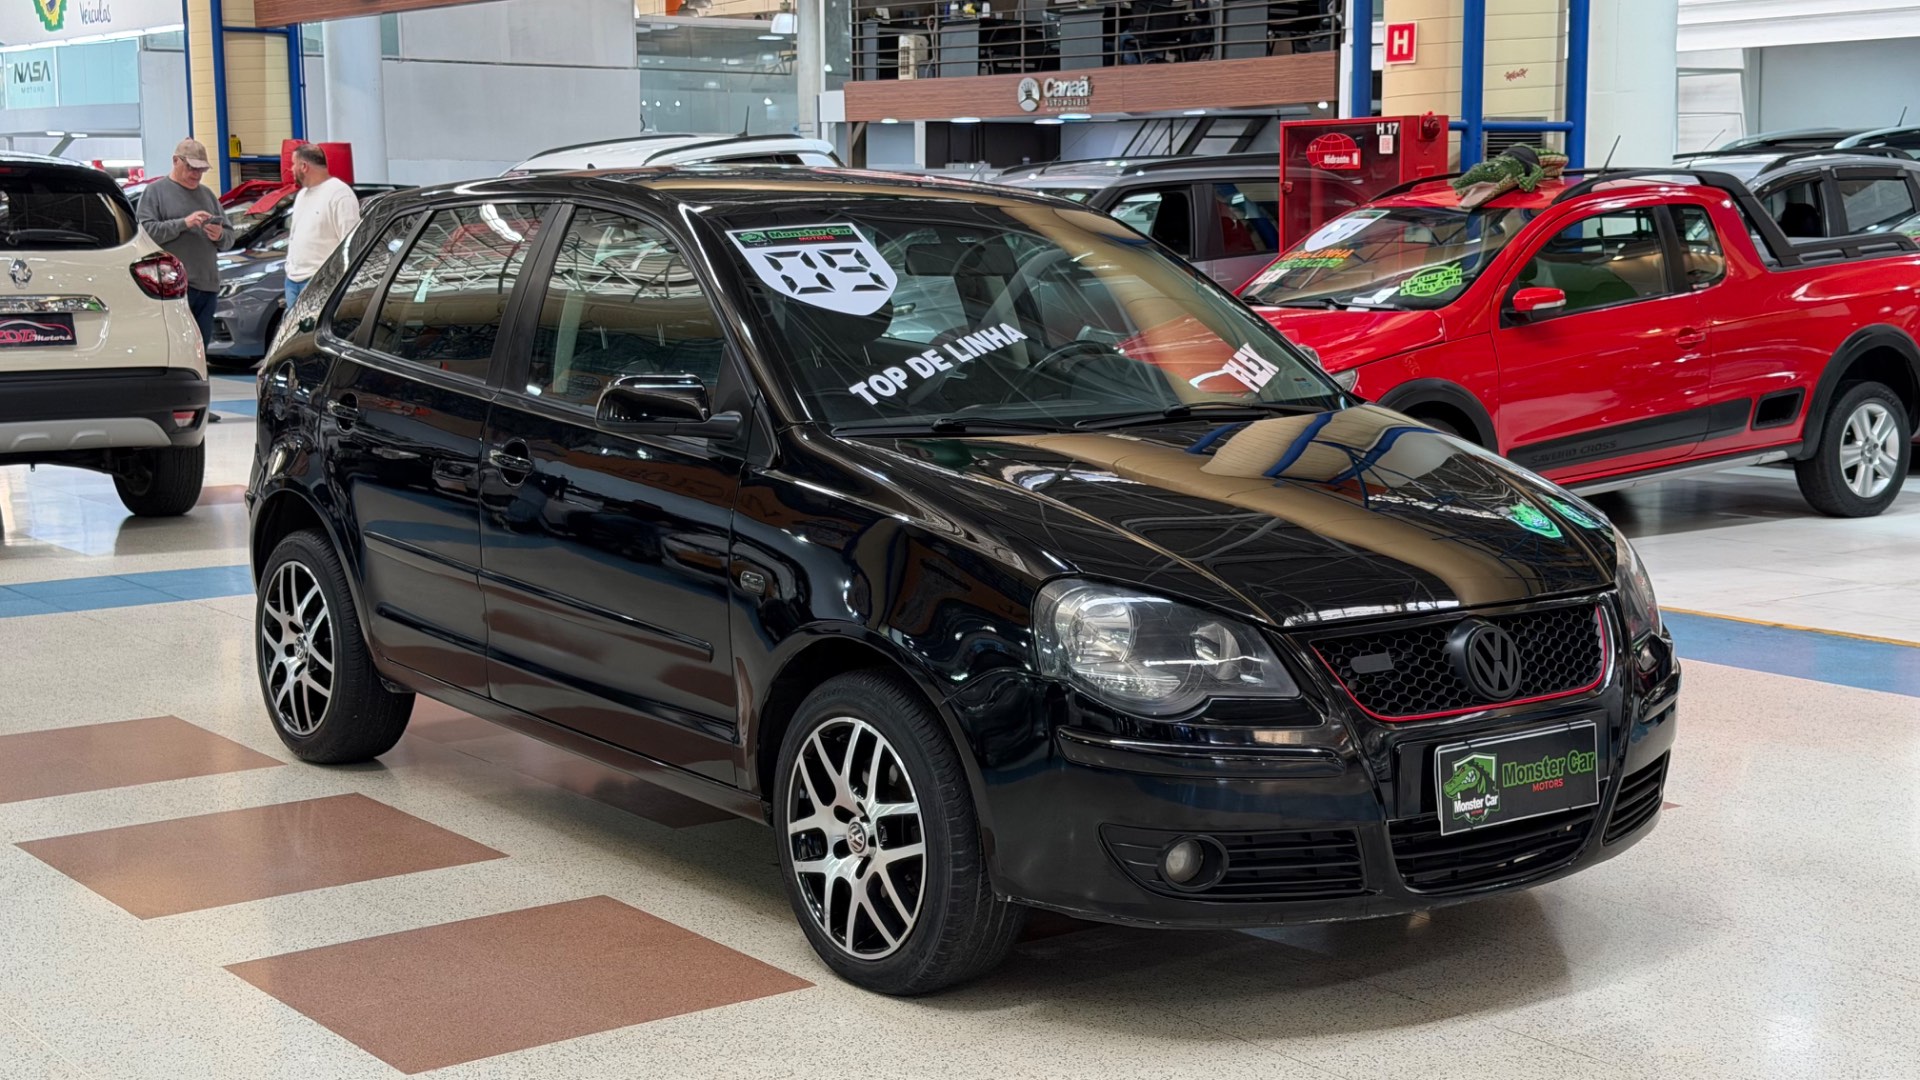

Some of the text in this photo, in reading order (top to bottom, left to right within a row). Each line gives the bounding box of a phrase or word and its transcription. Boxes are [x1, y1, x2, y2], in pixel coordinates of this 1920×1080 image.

[1393, 29, 1409, 55] H
[14, 60, 51, 83] NASA
[1043, 75, 1090, 97] Canaã
[1376, 122, 1399, 134] H 17
[1324, 154, 1350, 164] Hidrante
[768, 226, 853, 240] Monster Car
[763, 248, 889, 295] 09
[1400, 277, 1462, 296] APROVADO
[849, 322, 1028, 406] TOP DE LINHA
[1531, 440, 1617, 463] SAVEIRO CROSS
[1502, 749, 1595, 788] Monster Car
[1532, 778, 1564, 792] MOTORS
[1454, 793, 1498, 813] Monster Car
